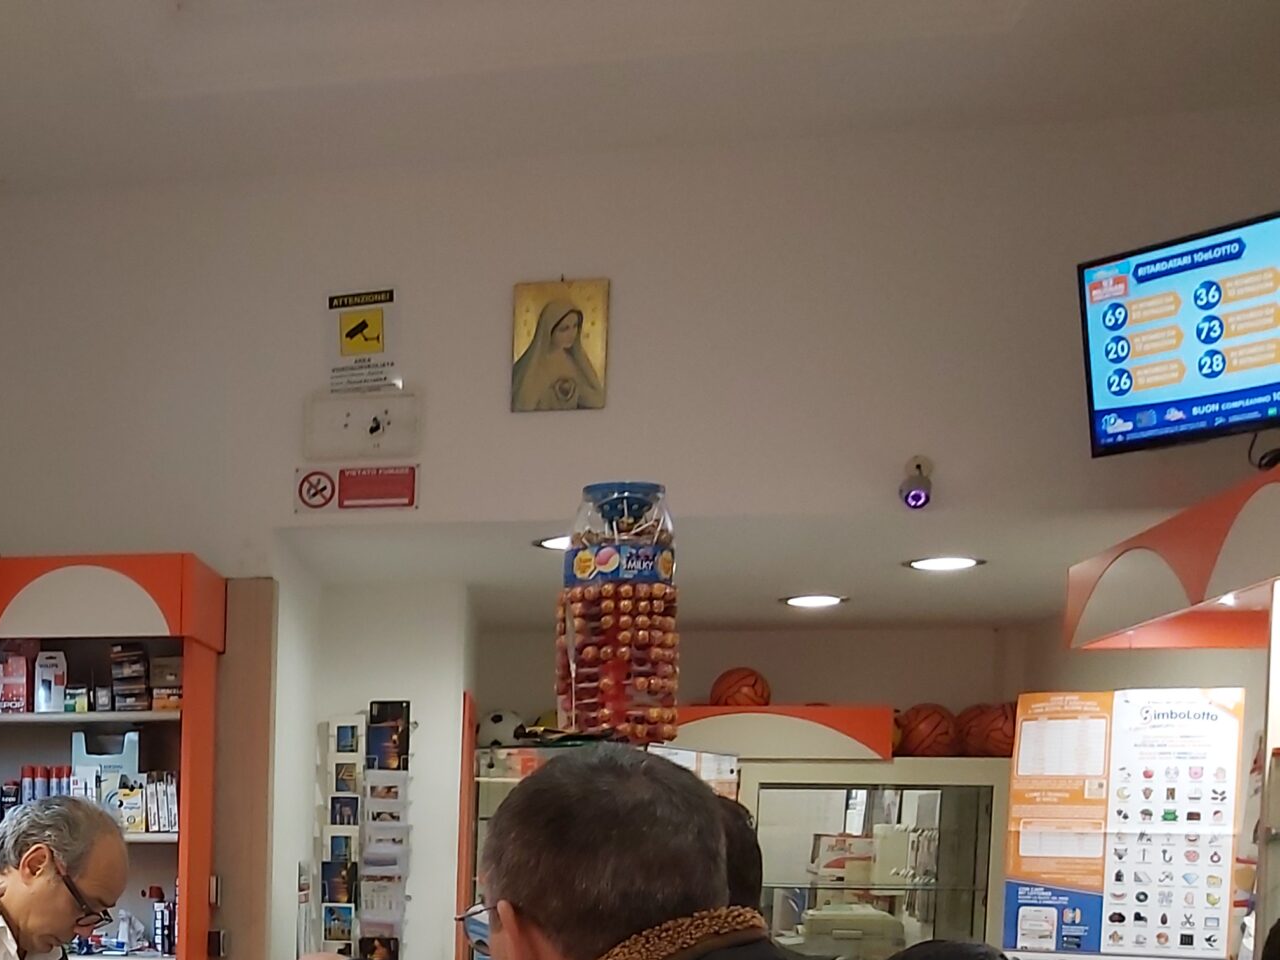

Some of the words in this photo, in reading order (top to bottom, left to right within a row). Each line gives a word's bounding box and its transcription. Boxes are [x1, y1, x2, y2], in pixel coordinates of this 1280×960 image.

[333, 291, 390, 307] ATTENZIONE!
[1196, 283, 1219, 304] 36
[1105, 306, 1125, 327] 69
[1198, 319, 1222, 340] 73
[1107, 340, 1129, 359] 20
[1201, 353, 1223, 373] 28
[1110, 372, 1131, 393] 26
[1192, 403, 1219, 415] BUON
